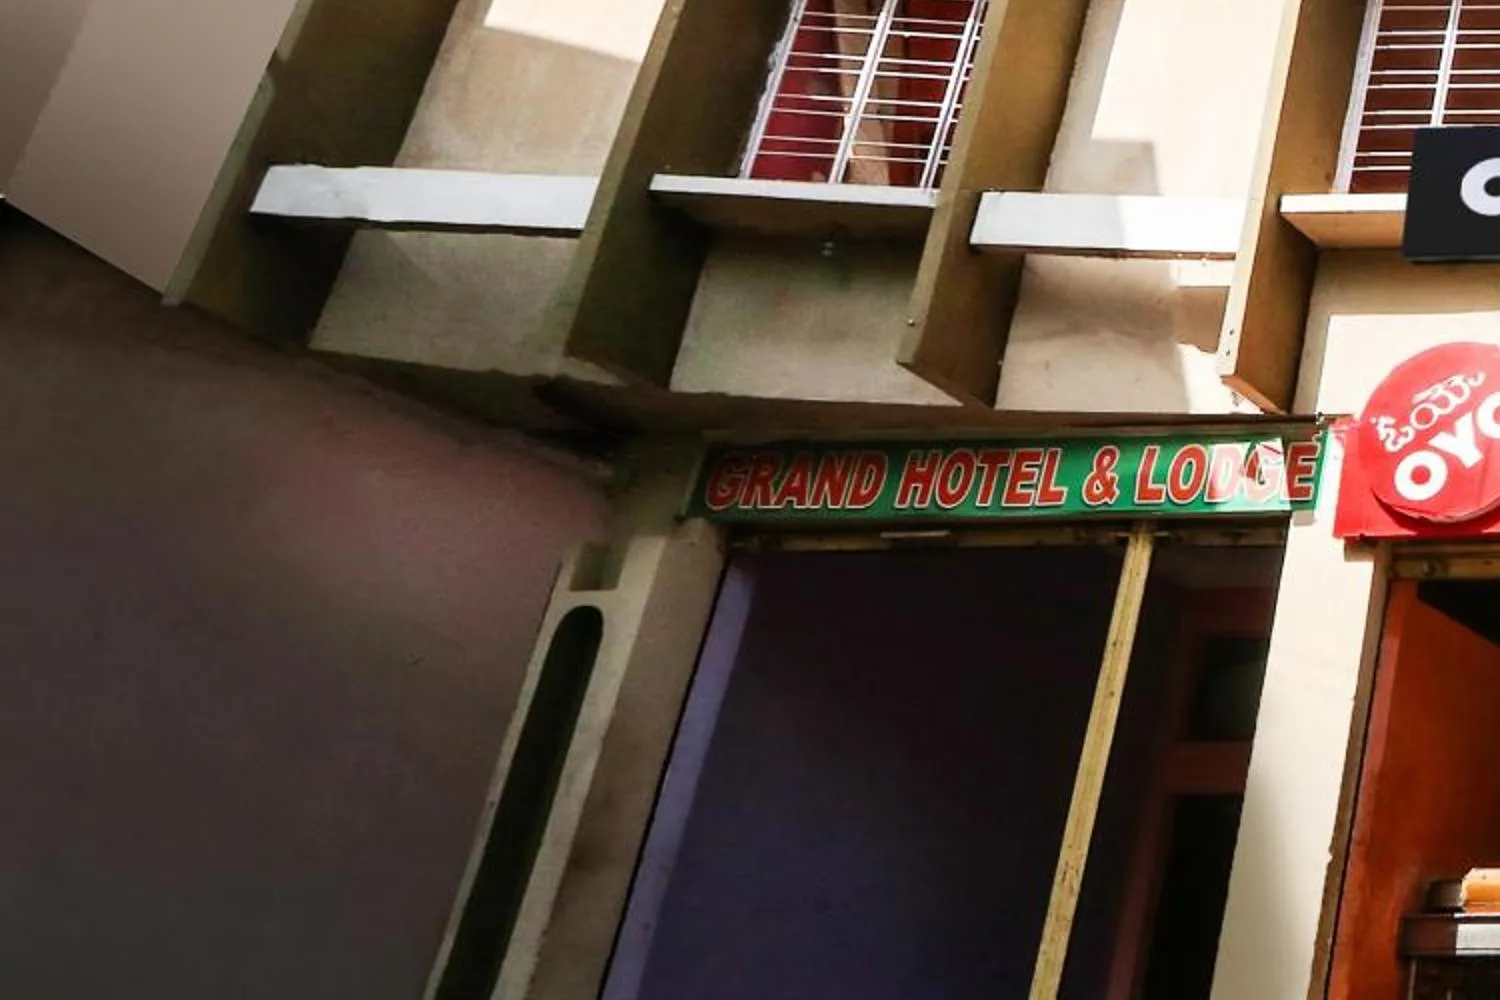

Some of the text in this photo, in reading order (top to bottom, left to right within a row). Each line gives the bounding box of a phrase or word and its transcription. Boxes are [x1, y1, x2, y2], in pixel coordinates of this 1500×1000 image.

[705, 442, 1318, 508] GRAND HOTEL & LODGE
